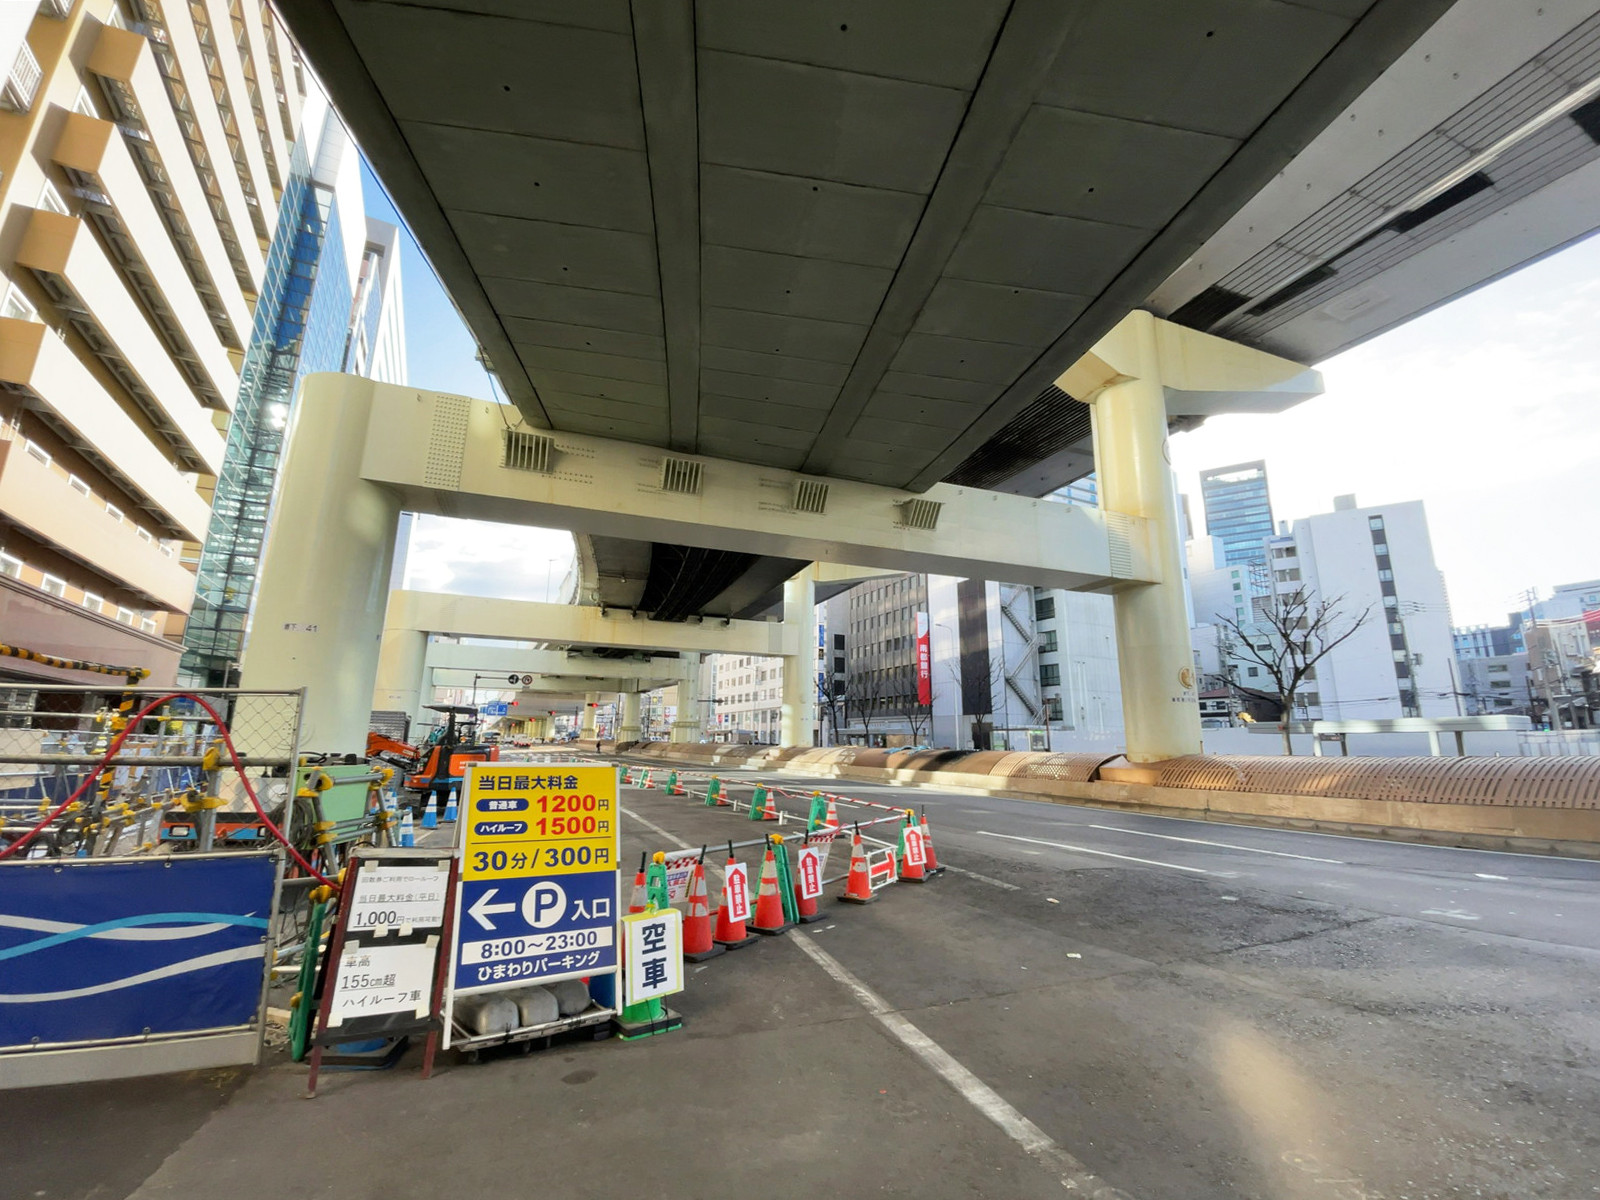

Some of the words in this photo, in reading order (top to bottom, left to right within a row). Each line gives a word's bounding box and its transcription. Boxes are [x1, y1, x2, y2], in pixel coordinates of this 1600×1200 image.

[478, 774, 579, 791] 当日最大料金
[536, 794, 609, 812] 1200円
[480, 823, 523, 833] ハイルーフ
[536, 815, 609, 835] 1500円
[534, 888, 558, 923] P
[571, 898, 610, 921] 入口
[344, 955, 371, 968] 車高
[642, 922, 667, 990] 空車
[478, 951, 600, 982] ひまわりパーキング
[343, 990, 422, 1007] ハイルーフ車
